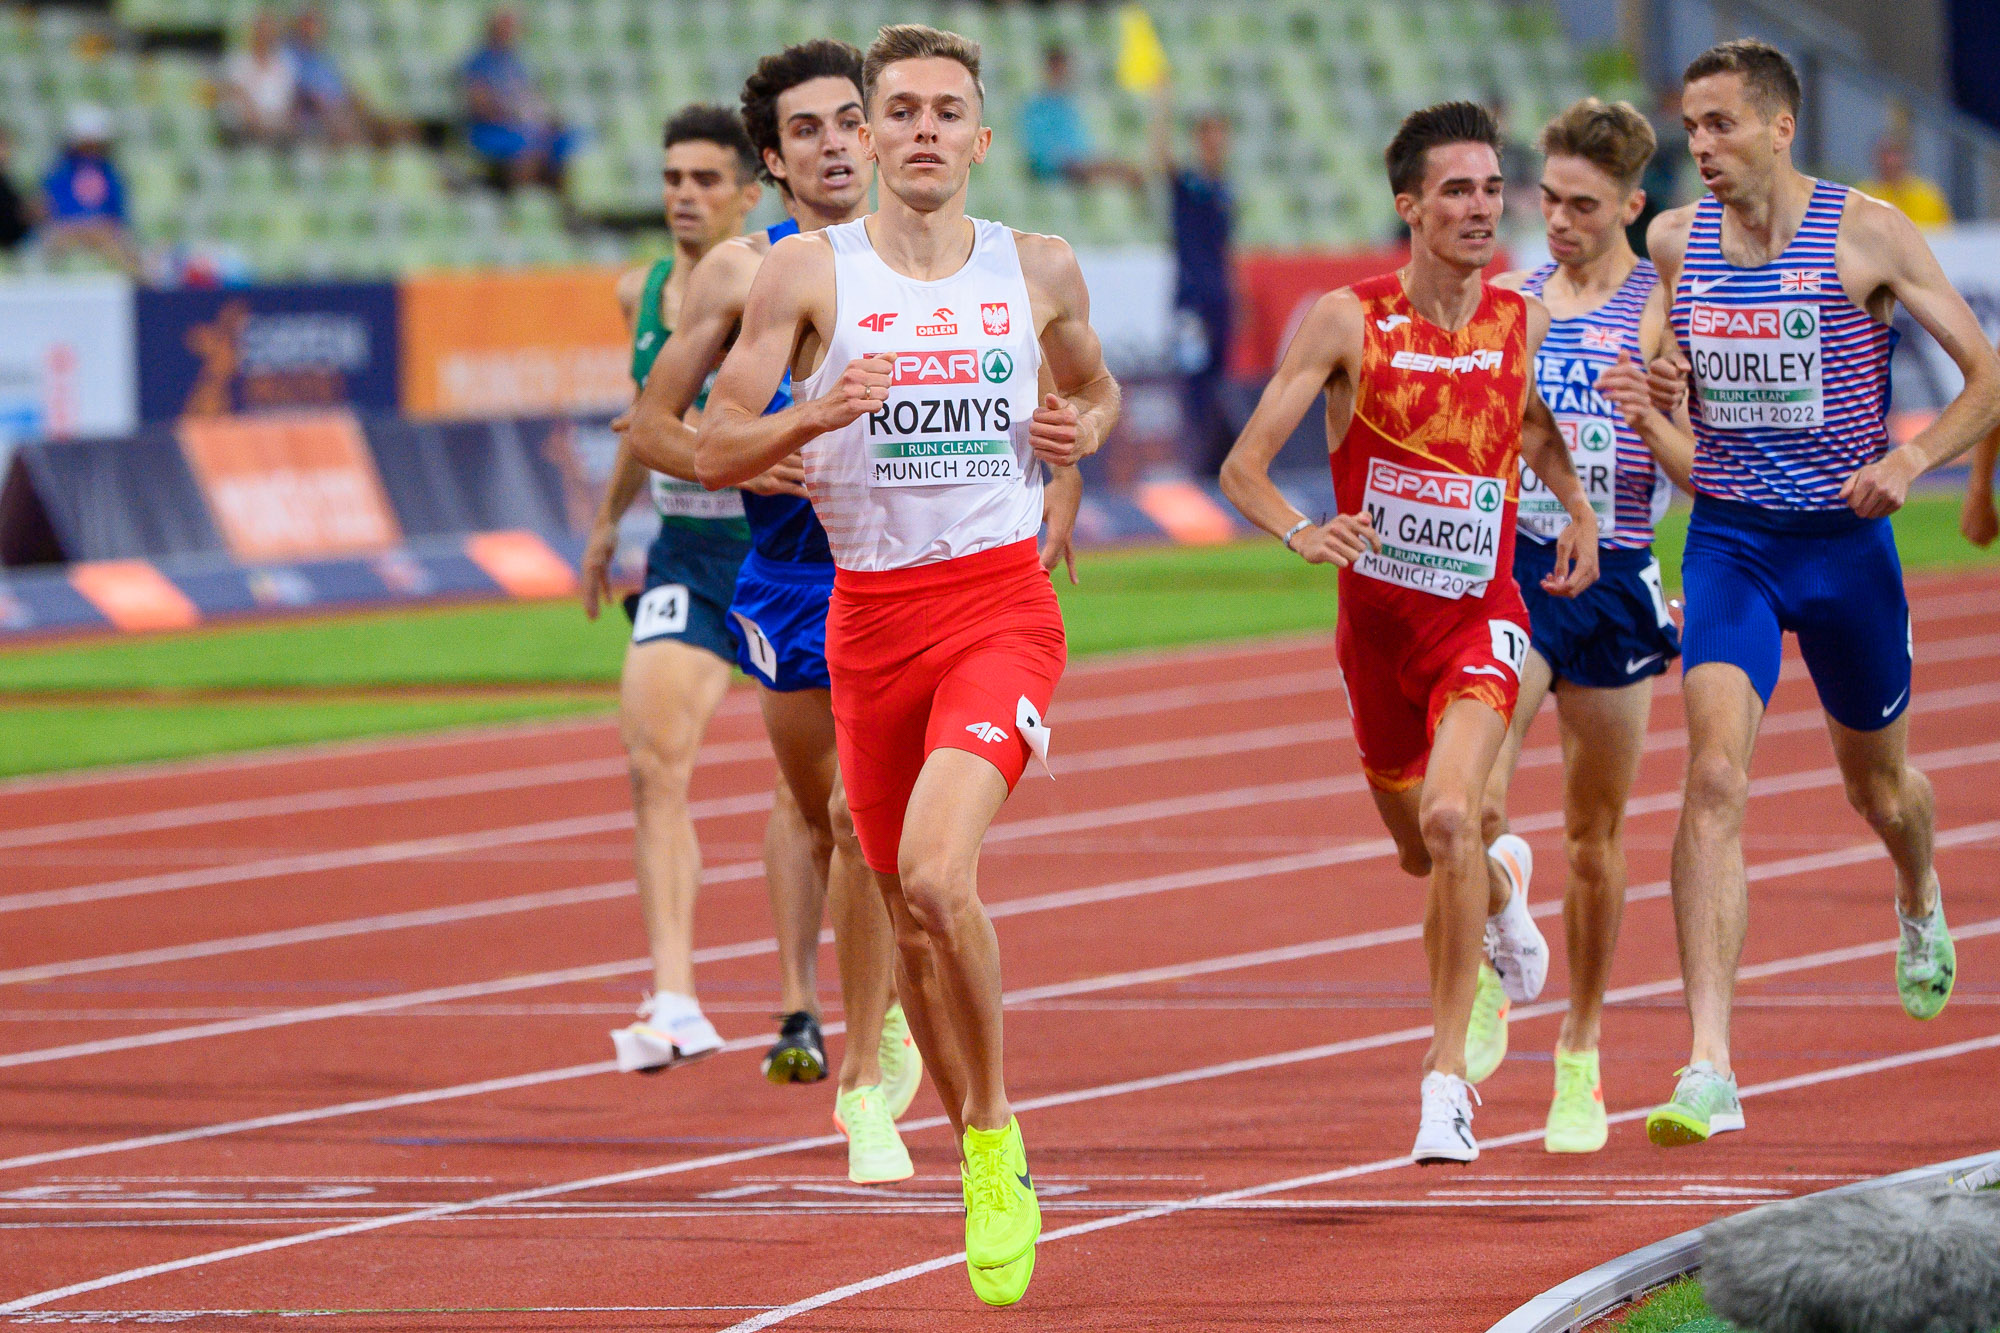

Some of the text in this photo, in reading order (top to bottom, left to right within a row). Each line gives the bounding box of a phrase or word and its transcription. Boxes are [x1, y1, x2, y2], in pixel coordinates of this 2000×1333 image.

[858, 313, 899, 332] 4F
[918, 326, 955, 336] ORLEN
[1693, 308, 1779, 336] SPAR
[890, 354, 976, 381] PAR
[1391, 349, 1503, 374] ESPAÑA
[1695, 350, 1815, 383] GOURLEY
[1718, 391, 1744, 401] RUN
[869, 397, 1011, 436] ROZMYS
[1770, 406, 1814, 423] 2022
[901, 445, 905, 455] I
[908, 444, 938, 455] RUN
[876, 460, 1011, 480] MUNICH 2022
[1373, 466, 1470, 506] SPAR
[1399, 513, 1494, 557] GARCÍA
[1393, 549, 1420, 562] RUN
[1363, 555, 1435, 587] MUNICH
[965, 721, 1009, 743] 4F
